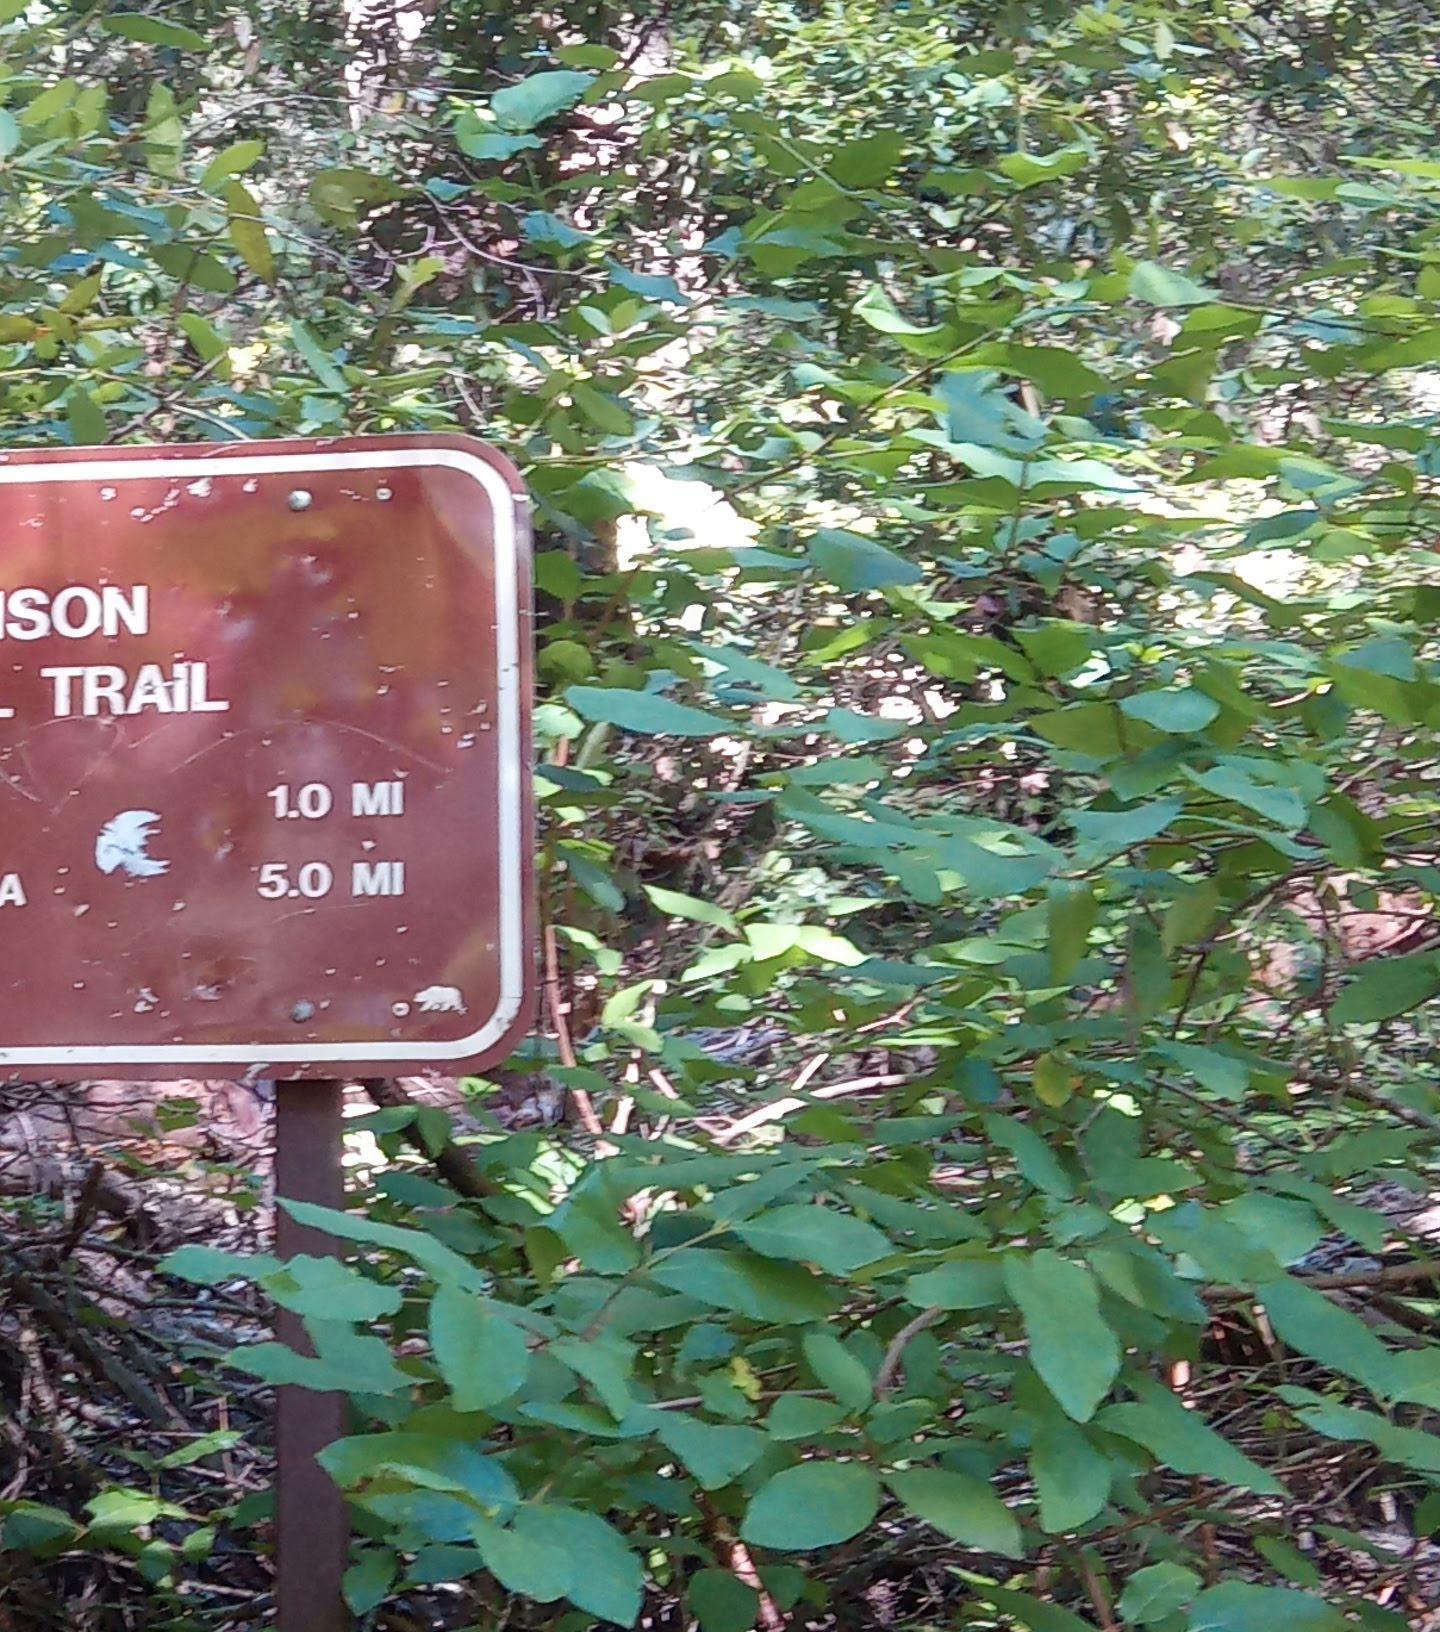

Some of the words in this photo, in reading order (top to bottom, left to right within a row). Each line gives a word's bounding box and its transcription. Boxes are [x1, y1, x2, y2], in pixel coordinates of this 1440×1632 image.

[42, 661, 229, 718] TRAIL
[267, 783, 332, 820] 1.0
[352, 782, 404, 817] MI
[257, 863, 332, 899] 5.0
[352, 861, 404, 897] MI
